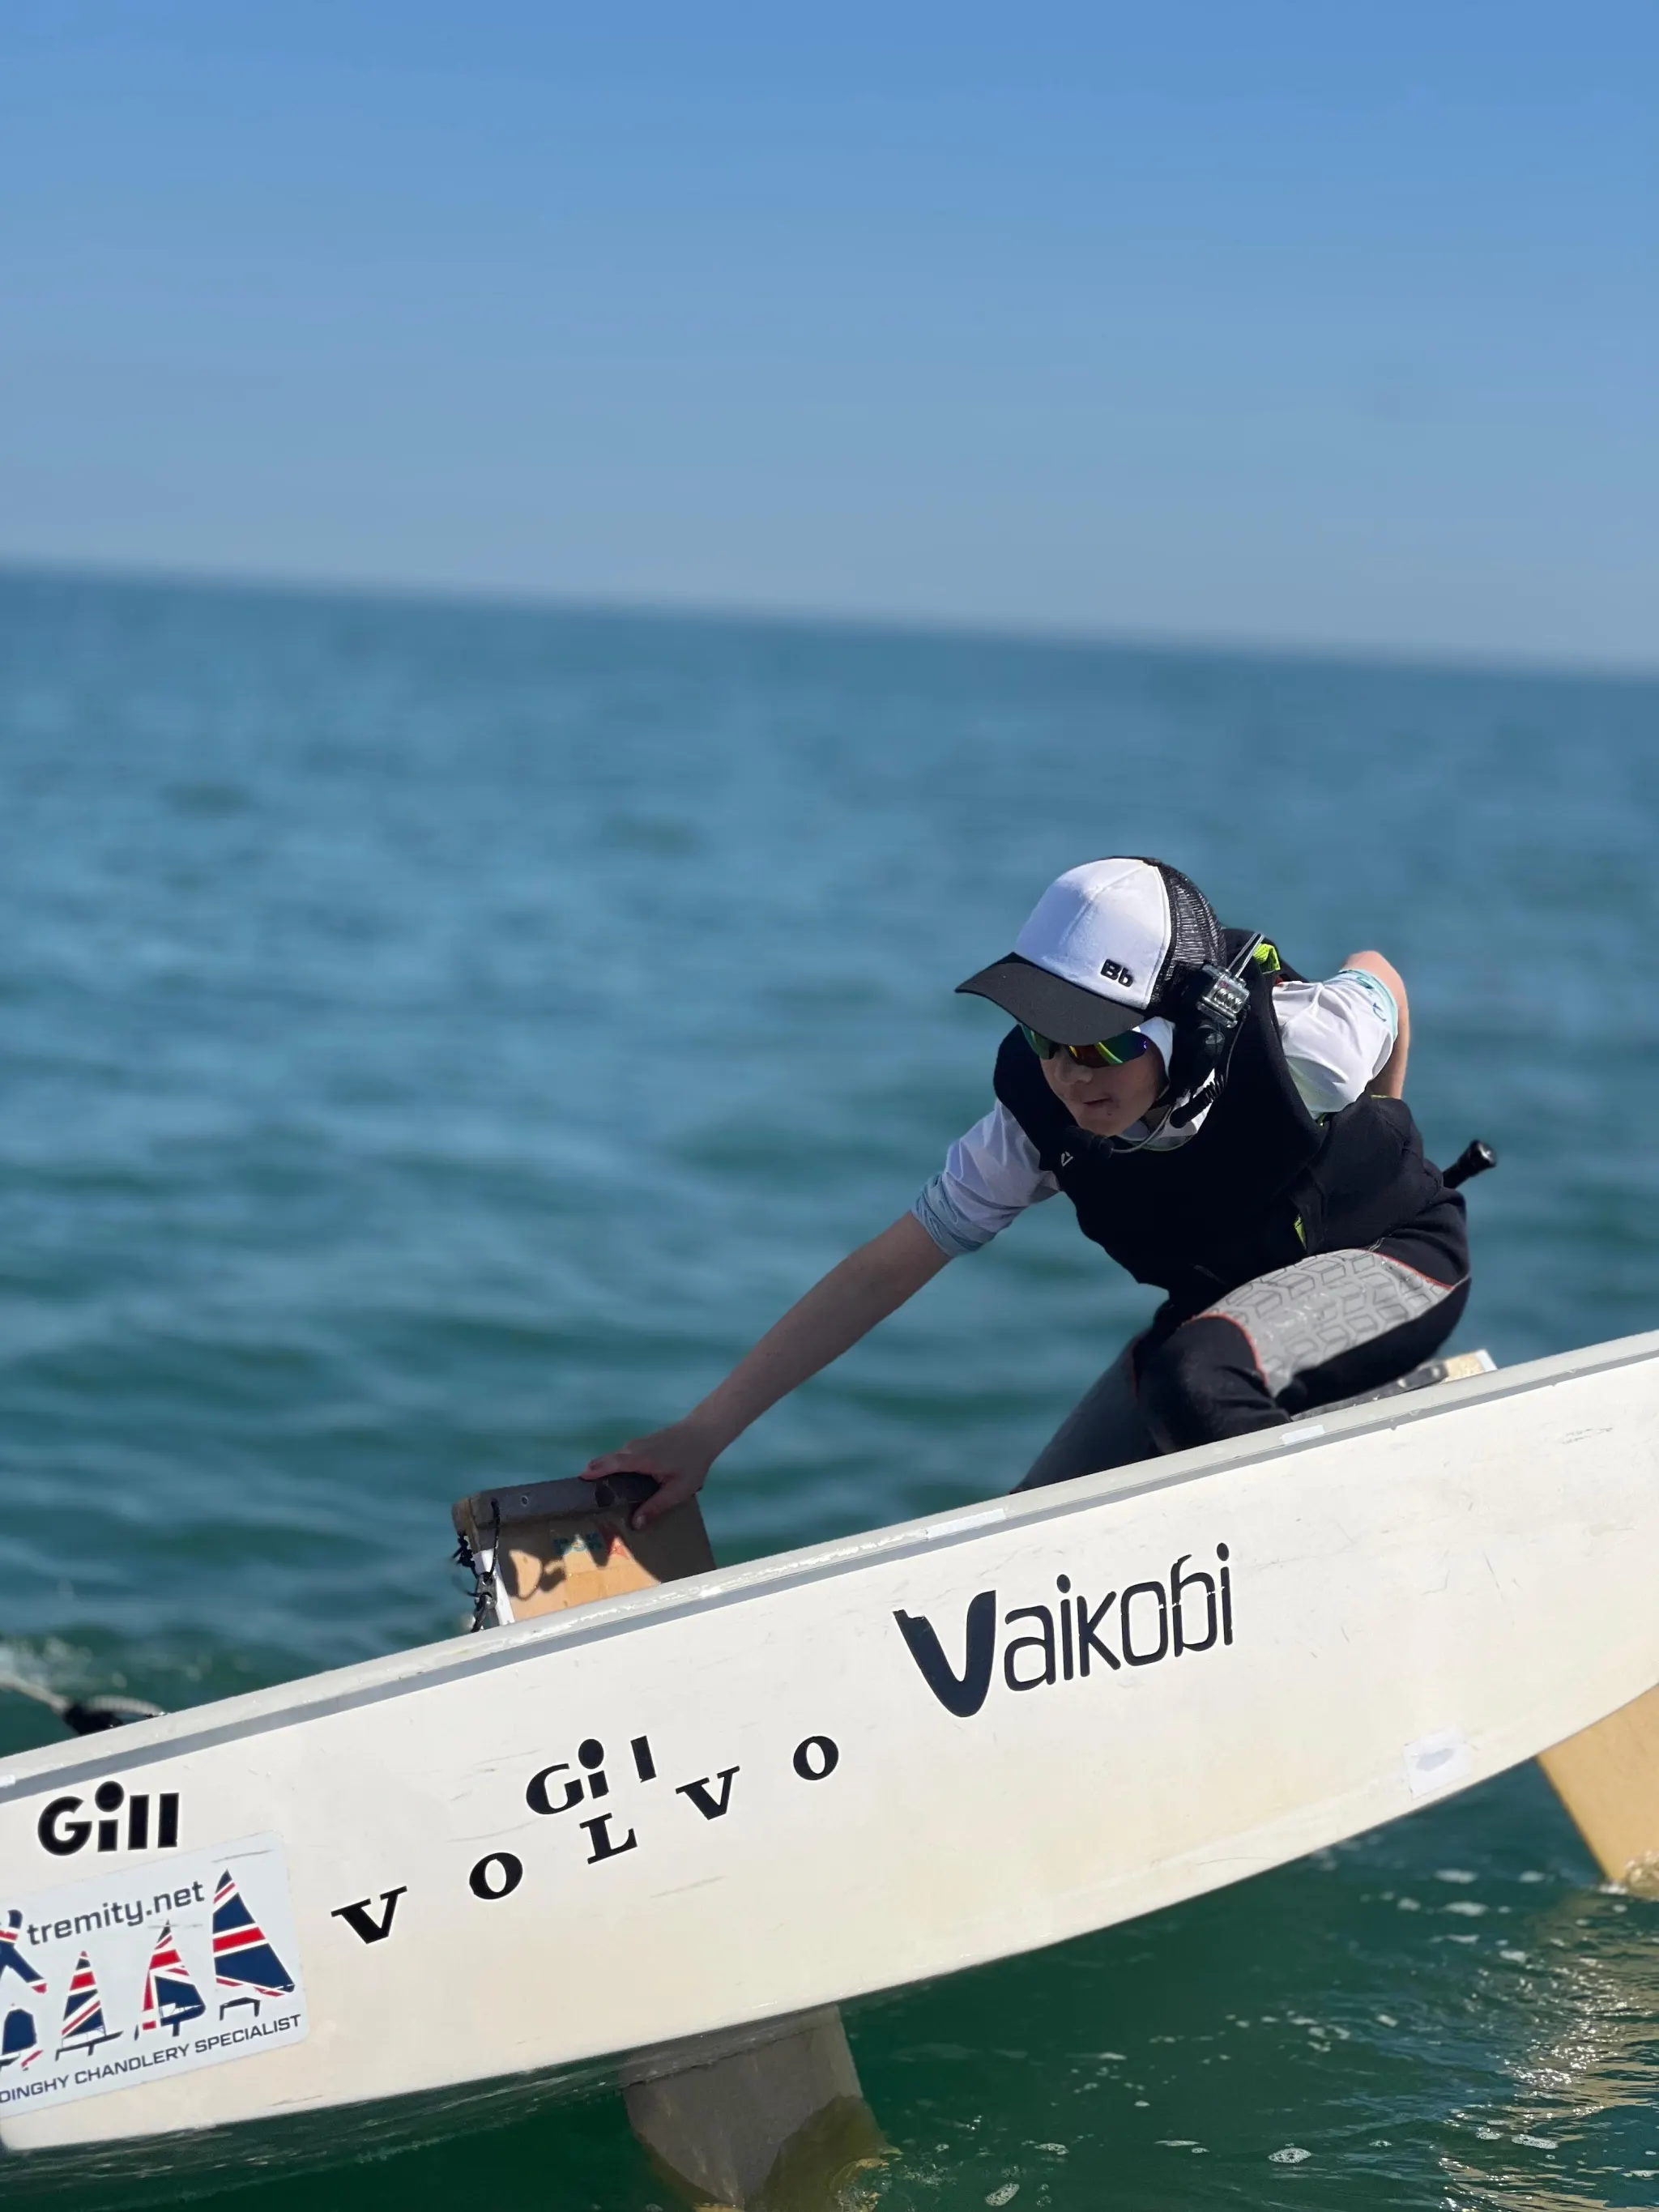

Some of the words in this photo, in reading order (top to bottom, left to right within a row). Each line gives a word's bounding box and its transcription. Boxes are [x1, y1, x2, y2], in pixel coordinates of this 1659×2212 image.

[1100, 958, 1133, 987] Bb
[893, 1542, 1234, 1718] Vaikobi
[37, 1780, 179, 1856] Gill
[0, 2074, 70, 2103] DINGHY
[75, 2044, 190, 2085] CHANDLERY
[194, 2014, 301, 2054] SPECIALIST
